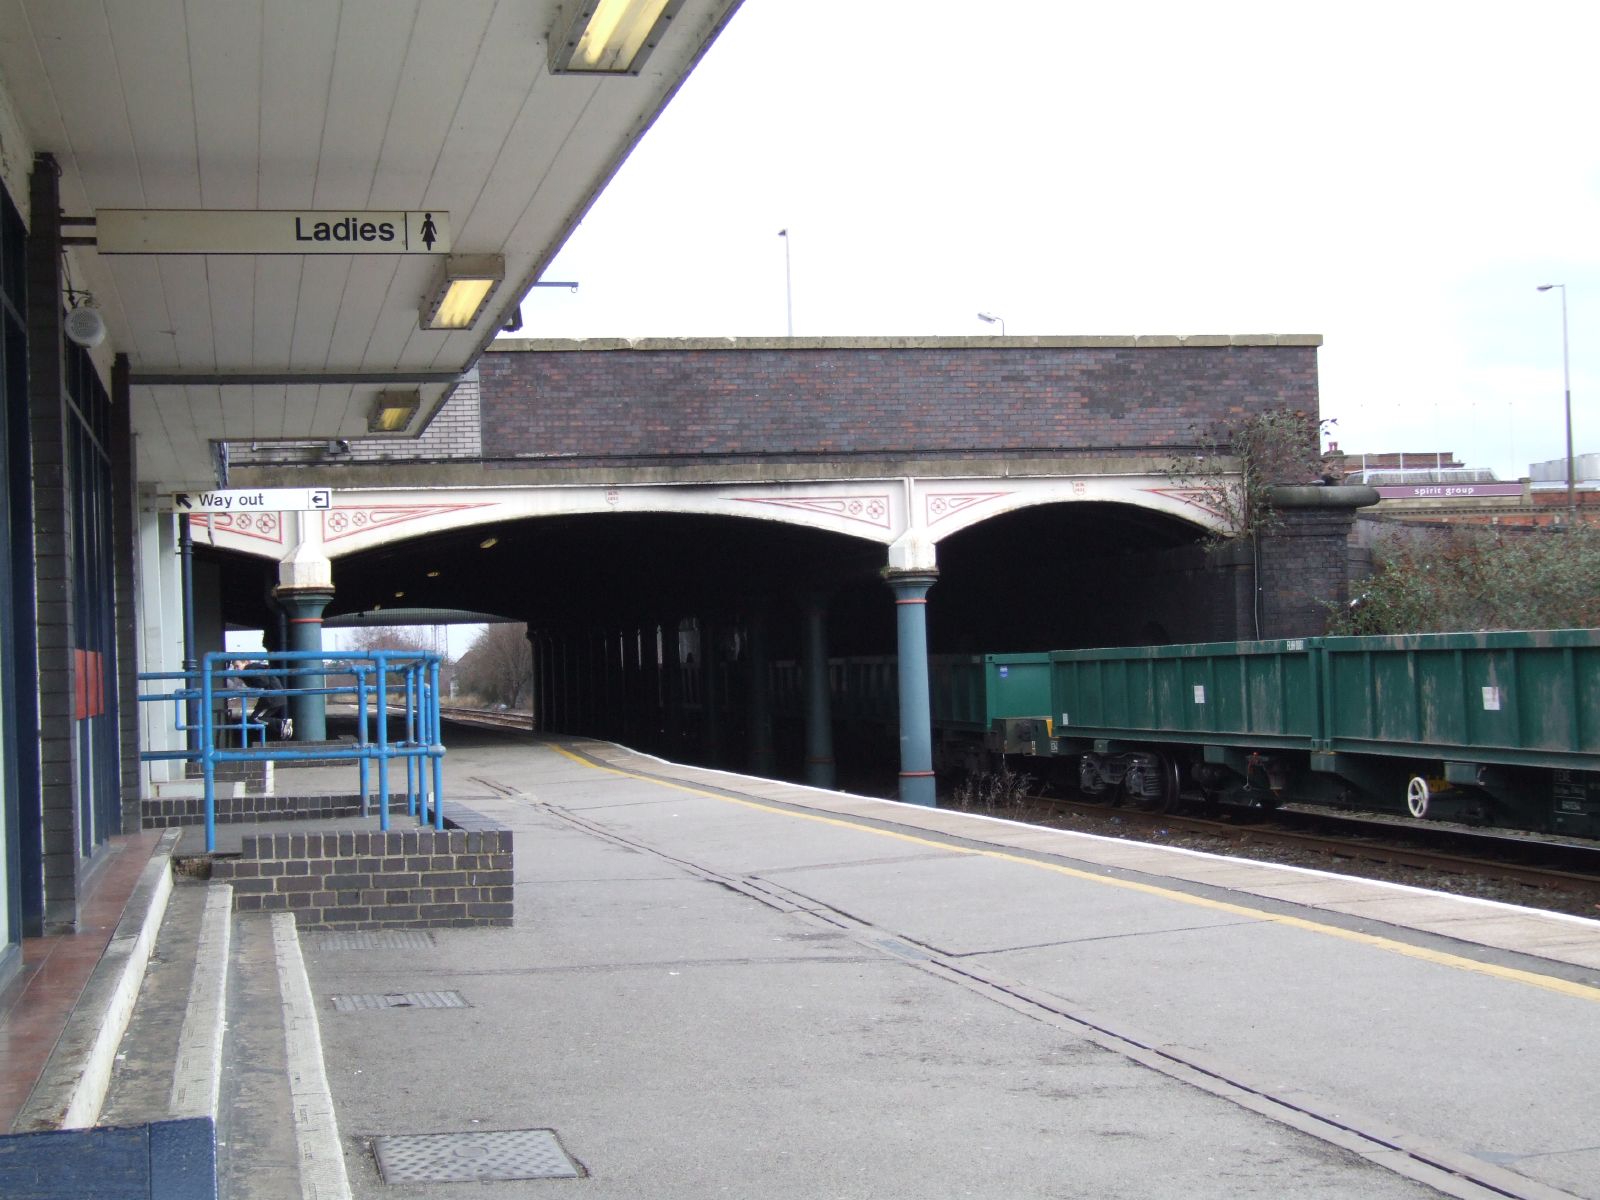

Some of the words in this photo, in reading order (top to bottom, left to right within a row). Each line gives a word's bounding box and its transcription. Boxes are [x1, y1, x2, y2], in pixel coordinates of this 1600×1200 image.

[295, 217, 395, 242] Ladies
[1414, 487, 1441, 497] spirit
[1445, 487, 1475, 496] group
[199, 493, 232, 509] Way
[239, 493, 264, 506] out
